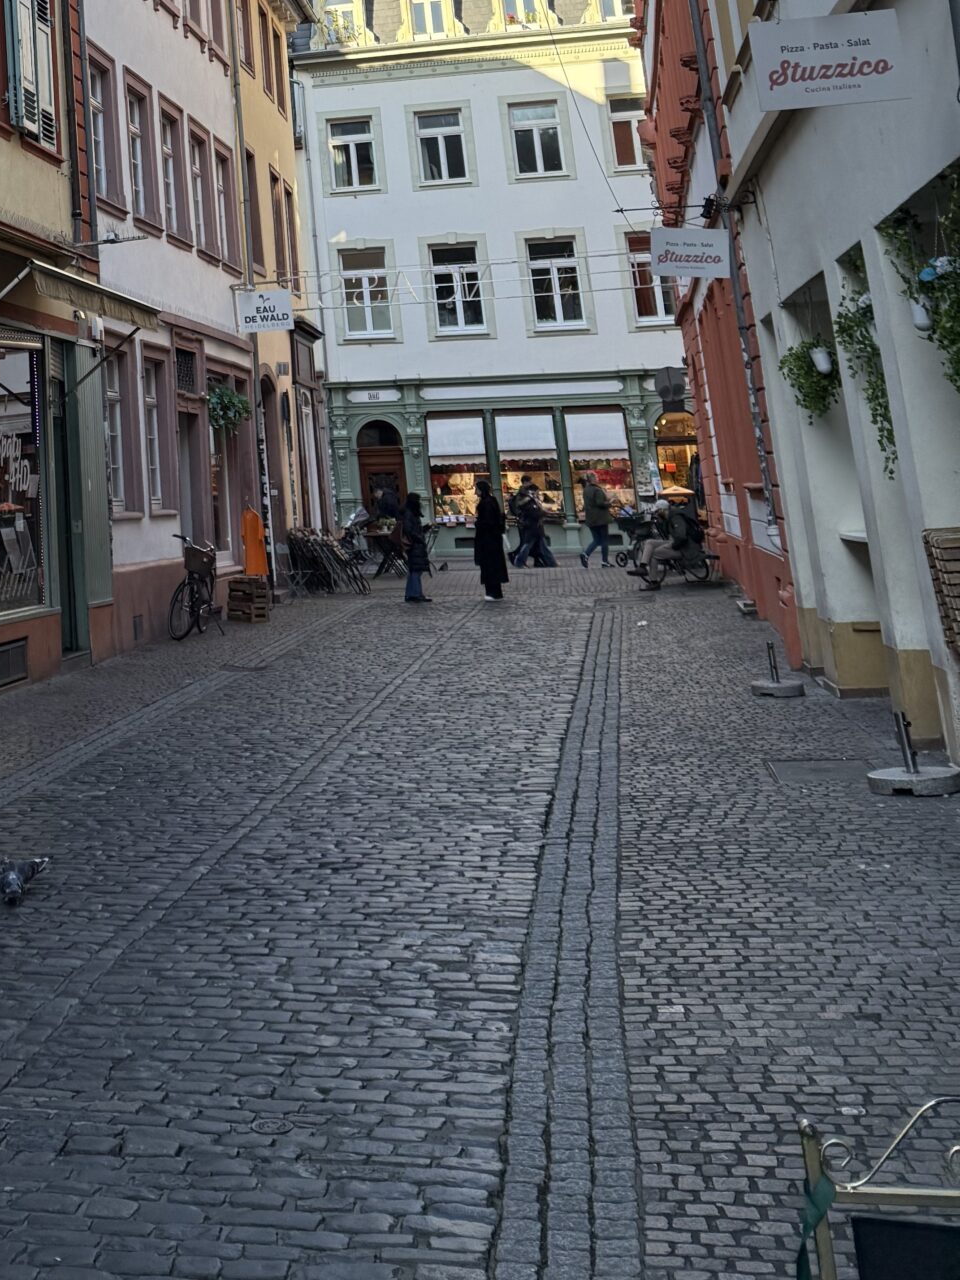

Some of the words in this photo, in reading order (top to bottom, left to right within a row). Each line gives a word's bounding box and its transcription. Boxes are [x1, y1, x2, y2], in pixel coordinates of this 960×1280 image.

[780, 44, 805, 54] Pizza
[812, 41, 839, 51] Pasta
[846, 37, 871, 48] Salat
[768, 56, 894, 91] Stuzzico
[804, 86, 831, 94] Cucina
[832, 83, 862, 92] Italiana
[657, 249, 724, 265] Stuzzico
[255, 305, 276, 314] EAU
[244, 316, 258, 324] DE
[259, 313, 290, 322] WALD
[244, 321, 291, 329] HEIDELBERG
